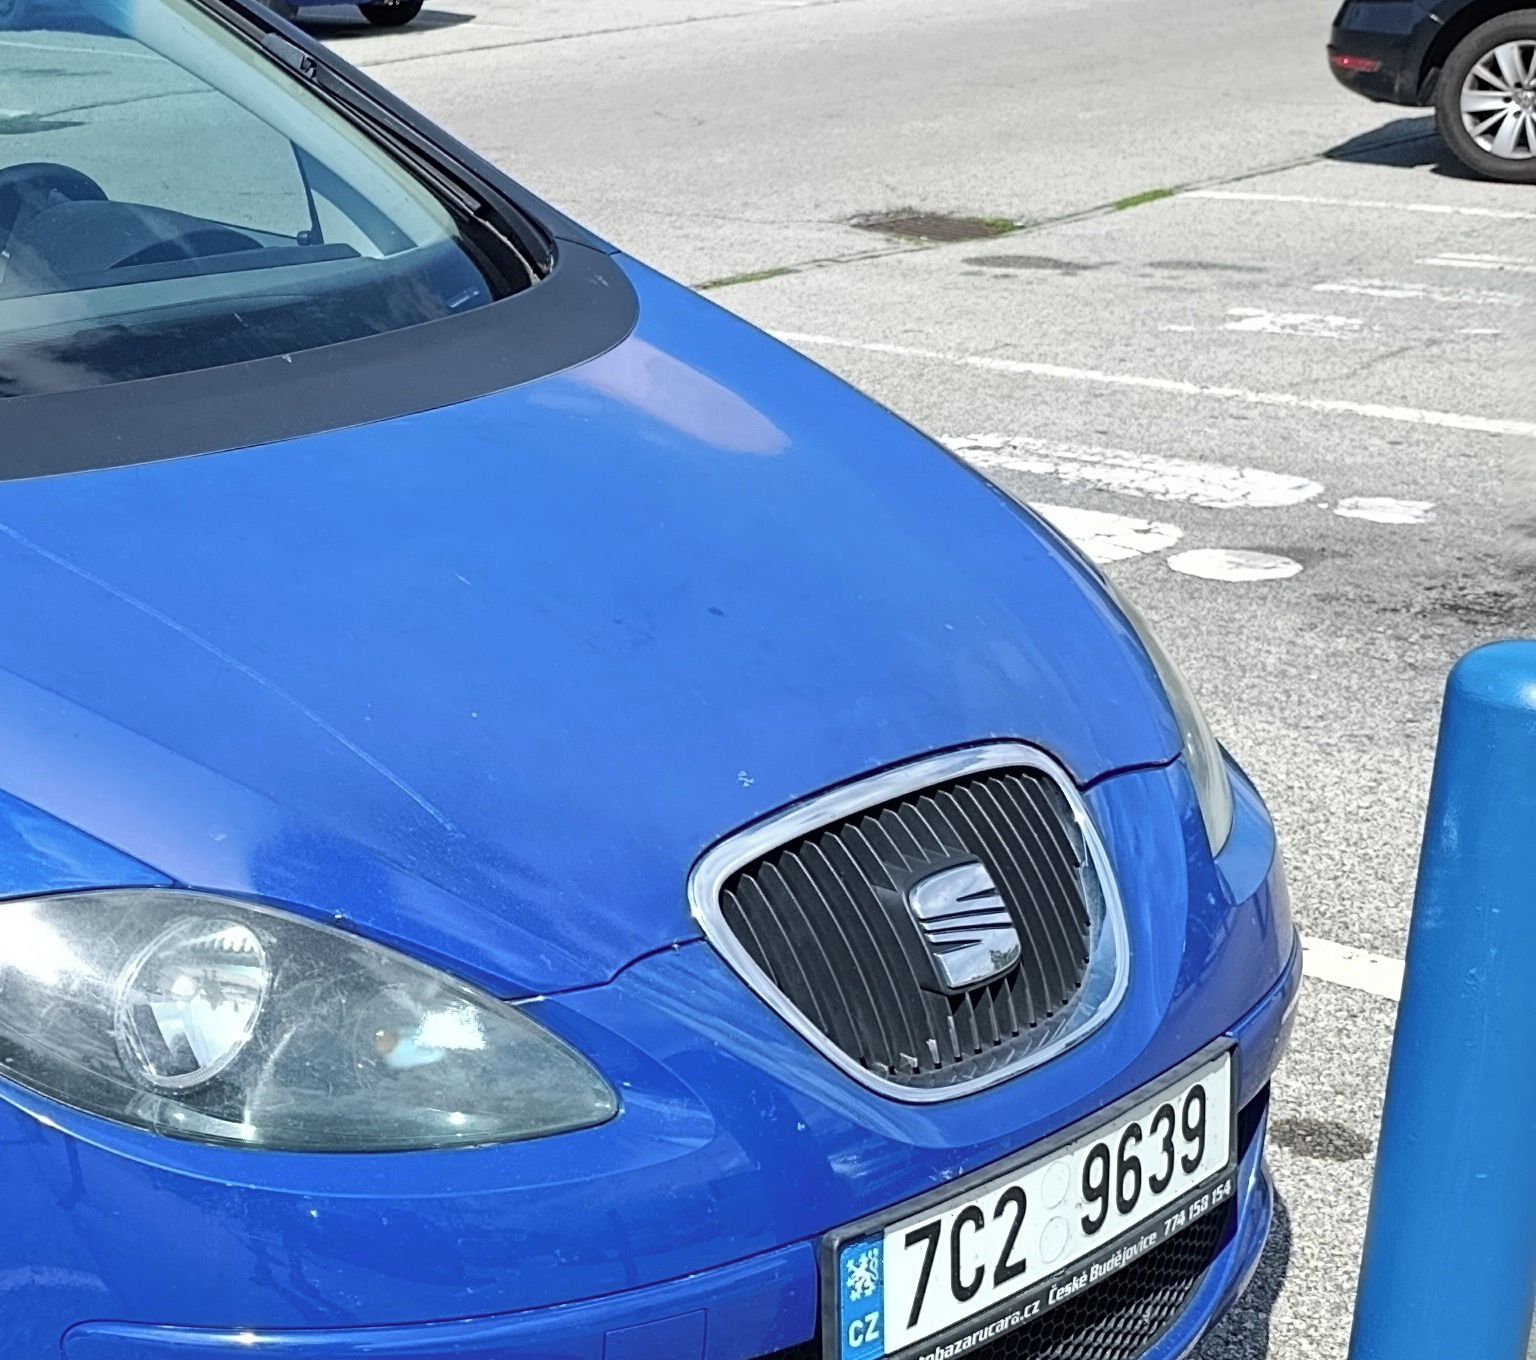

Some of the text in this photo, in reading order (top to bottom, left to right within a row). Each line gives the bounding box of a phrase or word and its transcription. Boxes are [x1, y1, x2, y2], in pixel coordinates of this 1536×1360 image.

[905, 1083, 1207, 1330] 7C2 9639
[1048, 1271, 1087, 1306] České
[1089, 1231, 1158, 1283] Budějovice
[1164, 1211, 1186, 1236] 774
[1211, 1179, 1232, 1205] 154
[848, 1311, 880, 1348] CZ
